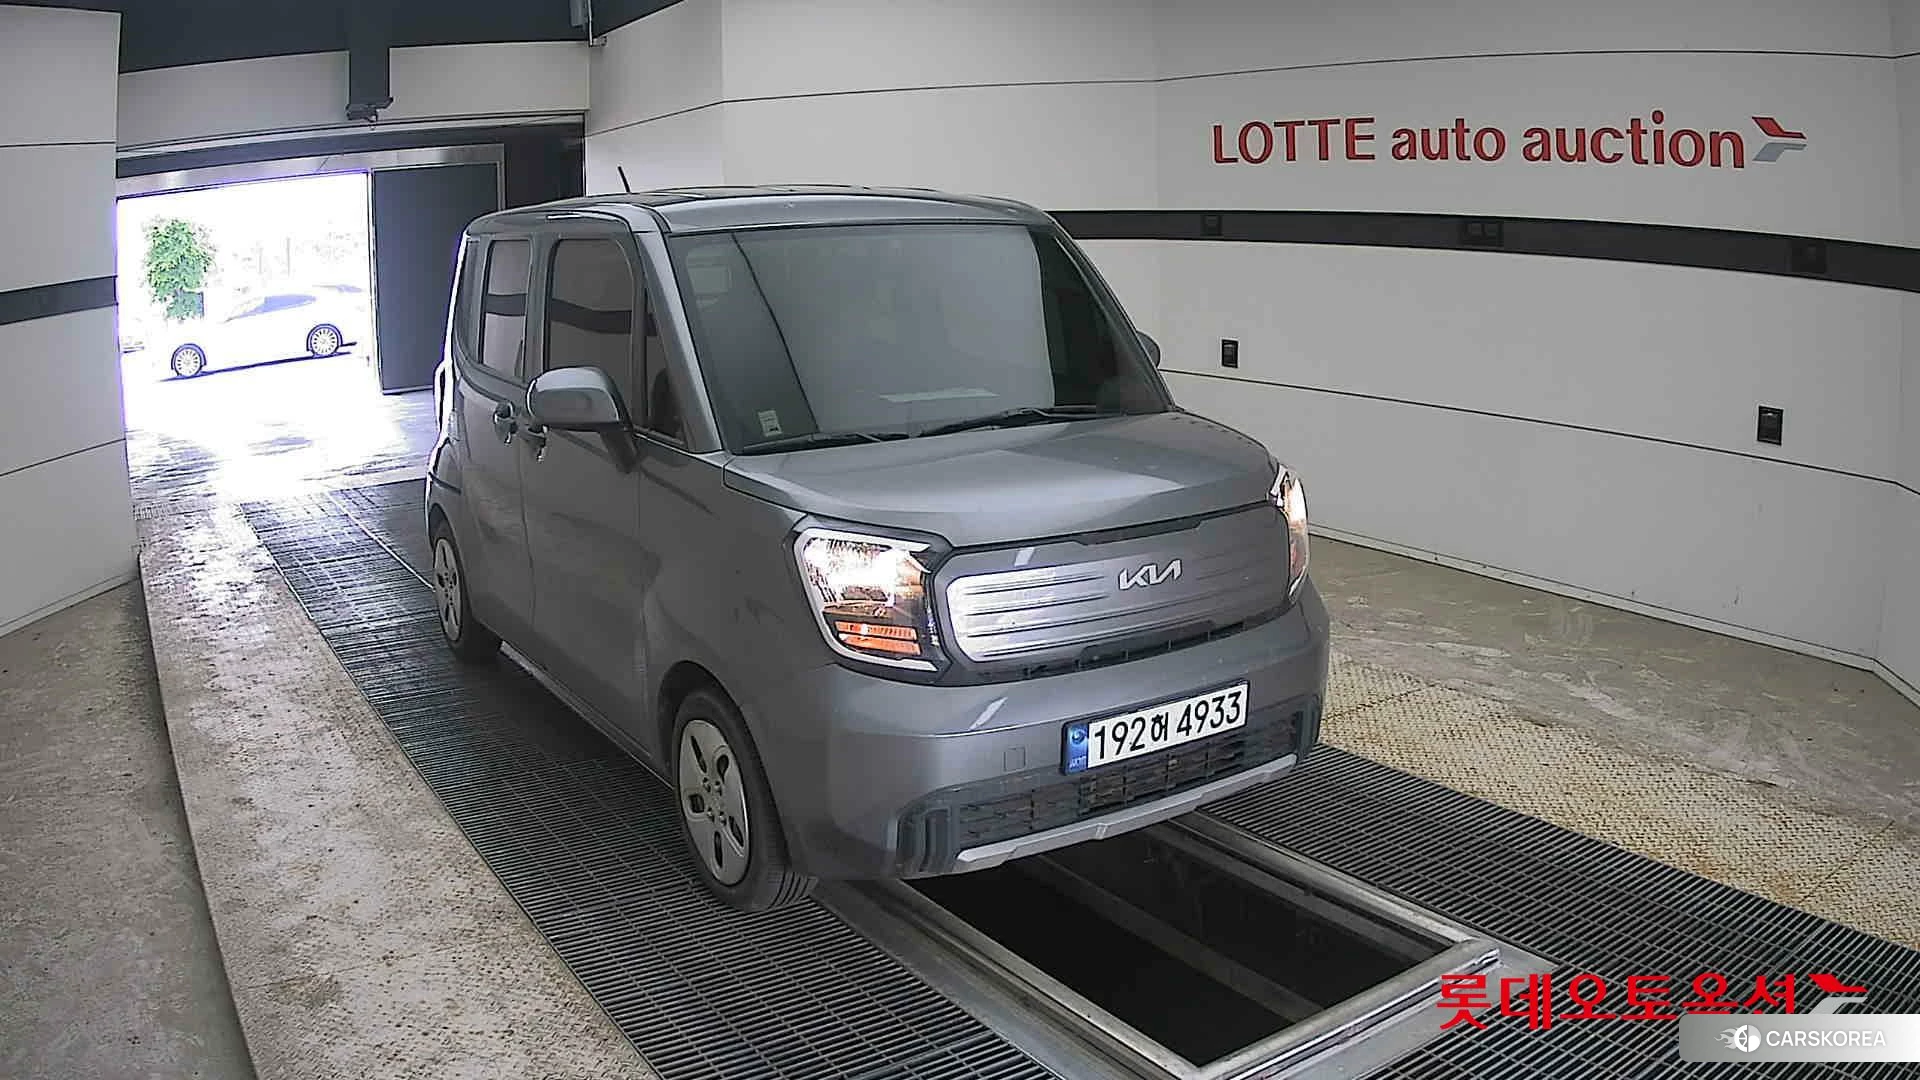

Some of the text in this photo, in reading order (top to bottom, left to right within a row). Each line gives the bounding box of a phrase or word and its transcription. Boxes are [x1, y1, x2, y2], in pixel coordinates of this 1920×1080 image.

[1211, 110, 1745, 169] LOTTE auto auction
[1119, 559, 1182, 590] KIA
[1094, 691, 1242, 760] 192허 4933
